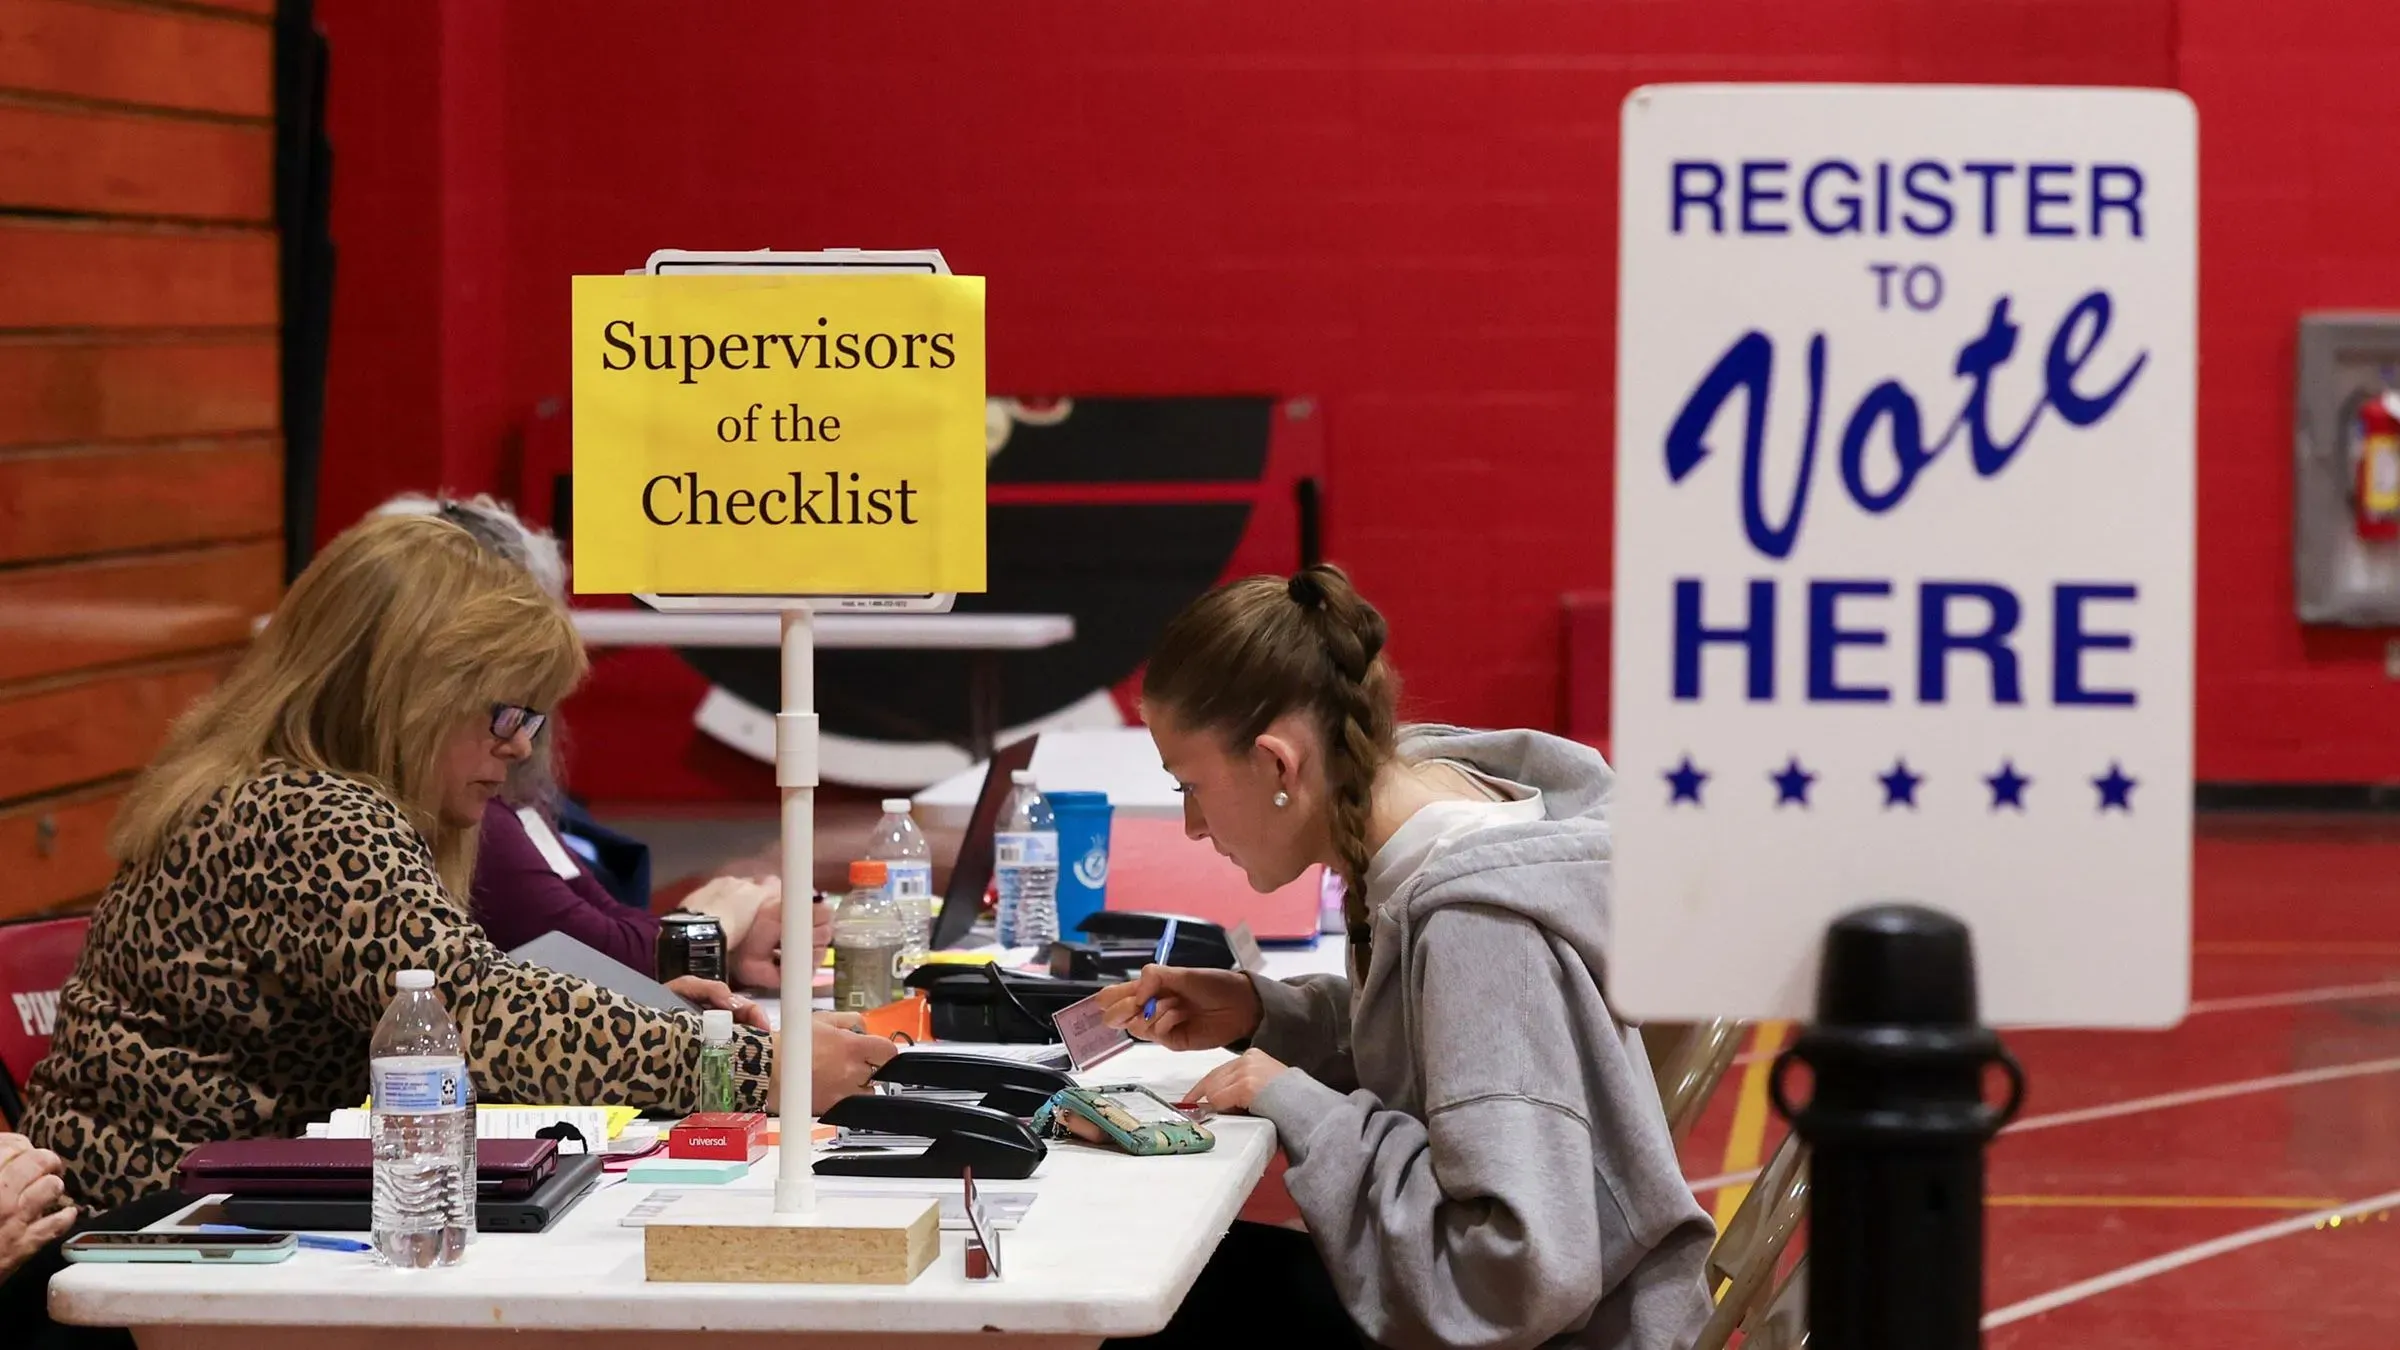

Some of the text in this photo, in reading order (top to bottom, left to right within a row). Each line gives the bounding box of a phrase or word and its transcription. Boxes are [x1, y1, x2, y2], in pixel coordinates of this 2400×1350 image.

[1672, 160, 2144, 237] REGISTER
[1869, 262, 1945, 312] TO
[602, 316, 956, 384] Supervisors
[717, 404, 841, 443] of the
[1664, 289, 2147, 560] Vote
[642, 472, 919, 526] Checklist
[1674, 580, 2136, 707] HERE
